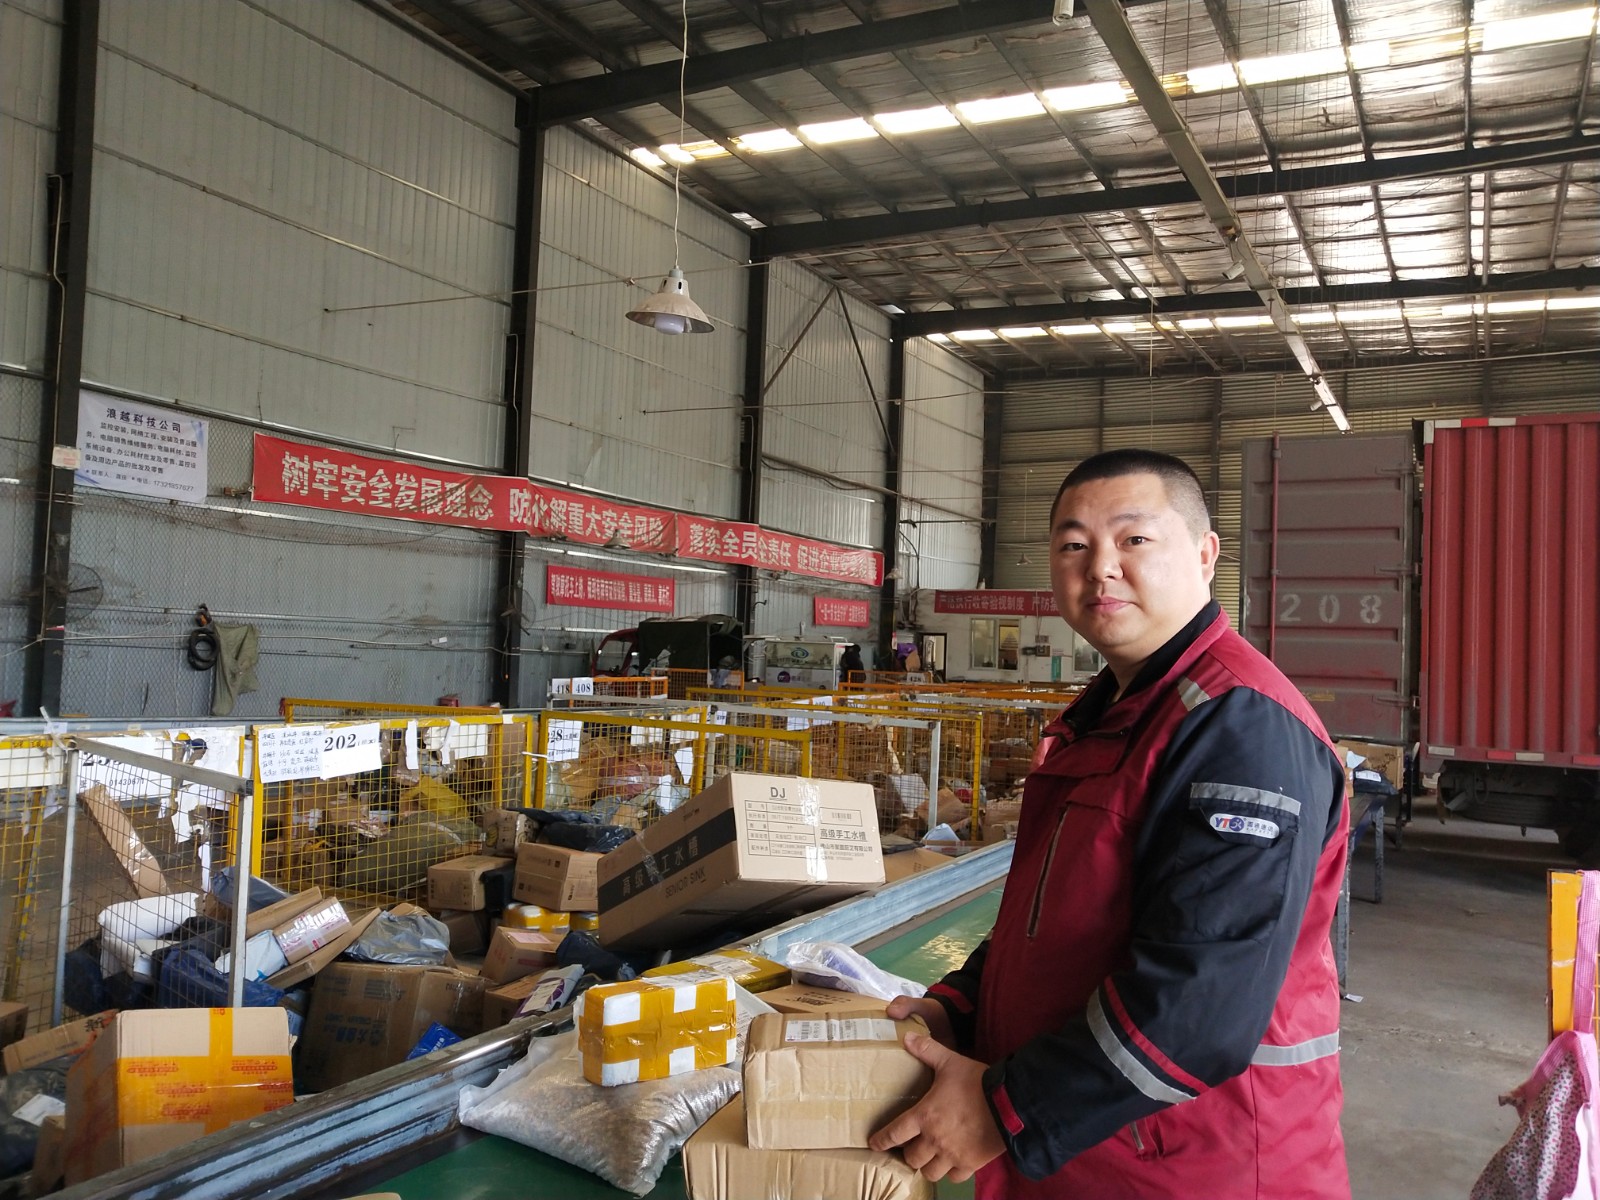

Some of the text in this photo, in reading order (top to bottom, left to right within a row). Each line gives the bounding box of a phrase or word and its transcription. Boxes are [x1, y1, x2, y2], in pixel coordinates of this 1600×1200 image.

[106, 407, 182, 433] 浪越科技公司
[281, 451, 494, 522] 树牢安全发展理念
[575, 682, 592, 693] 408
[323, 733, 357, 752] 202
[769, 787, 787, 798] DJ
[819, 828, 867, 841] 高级手工水槽
[623, 835, 699, 898] 高级工水槽
